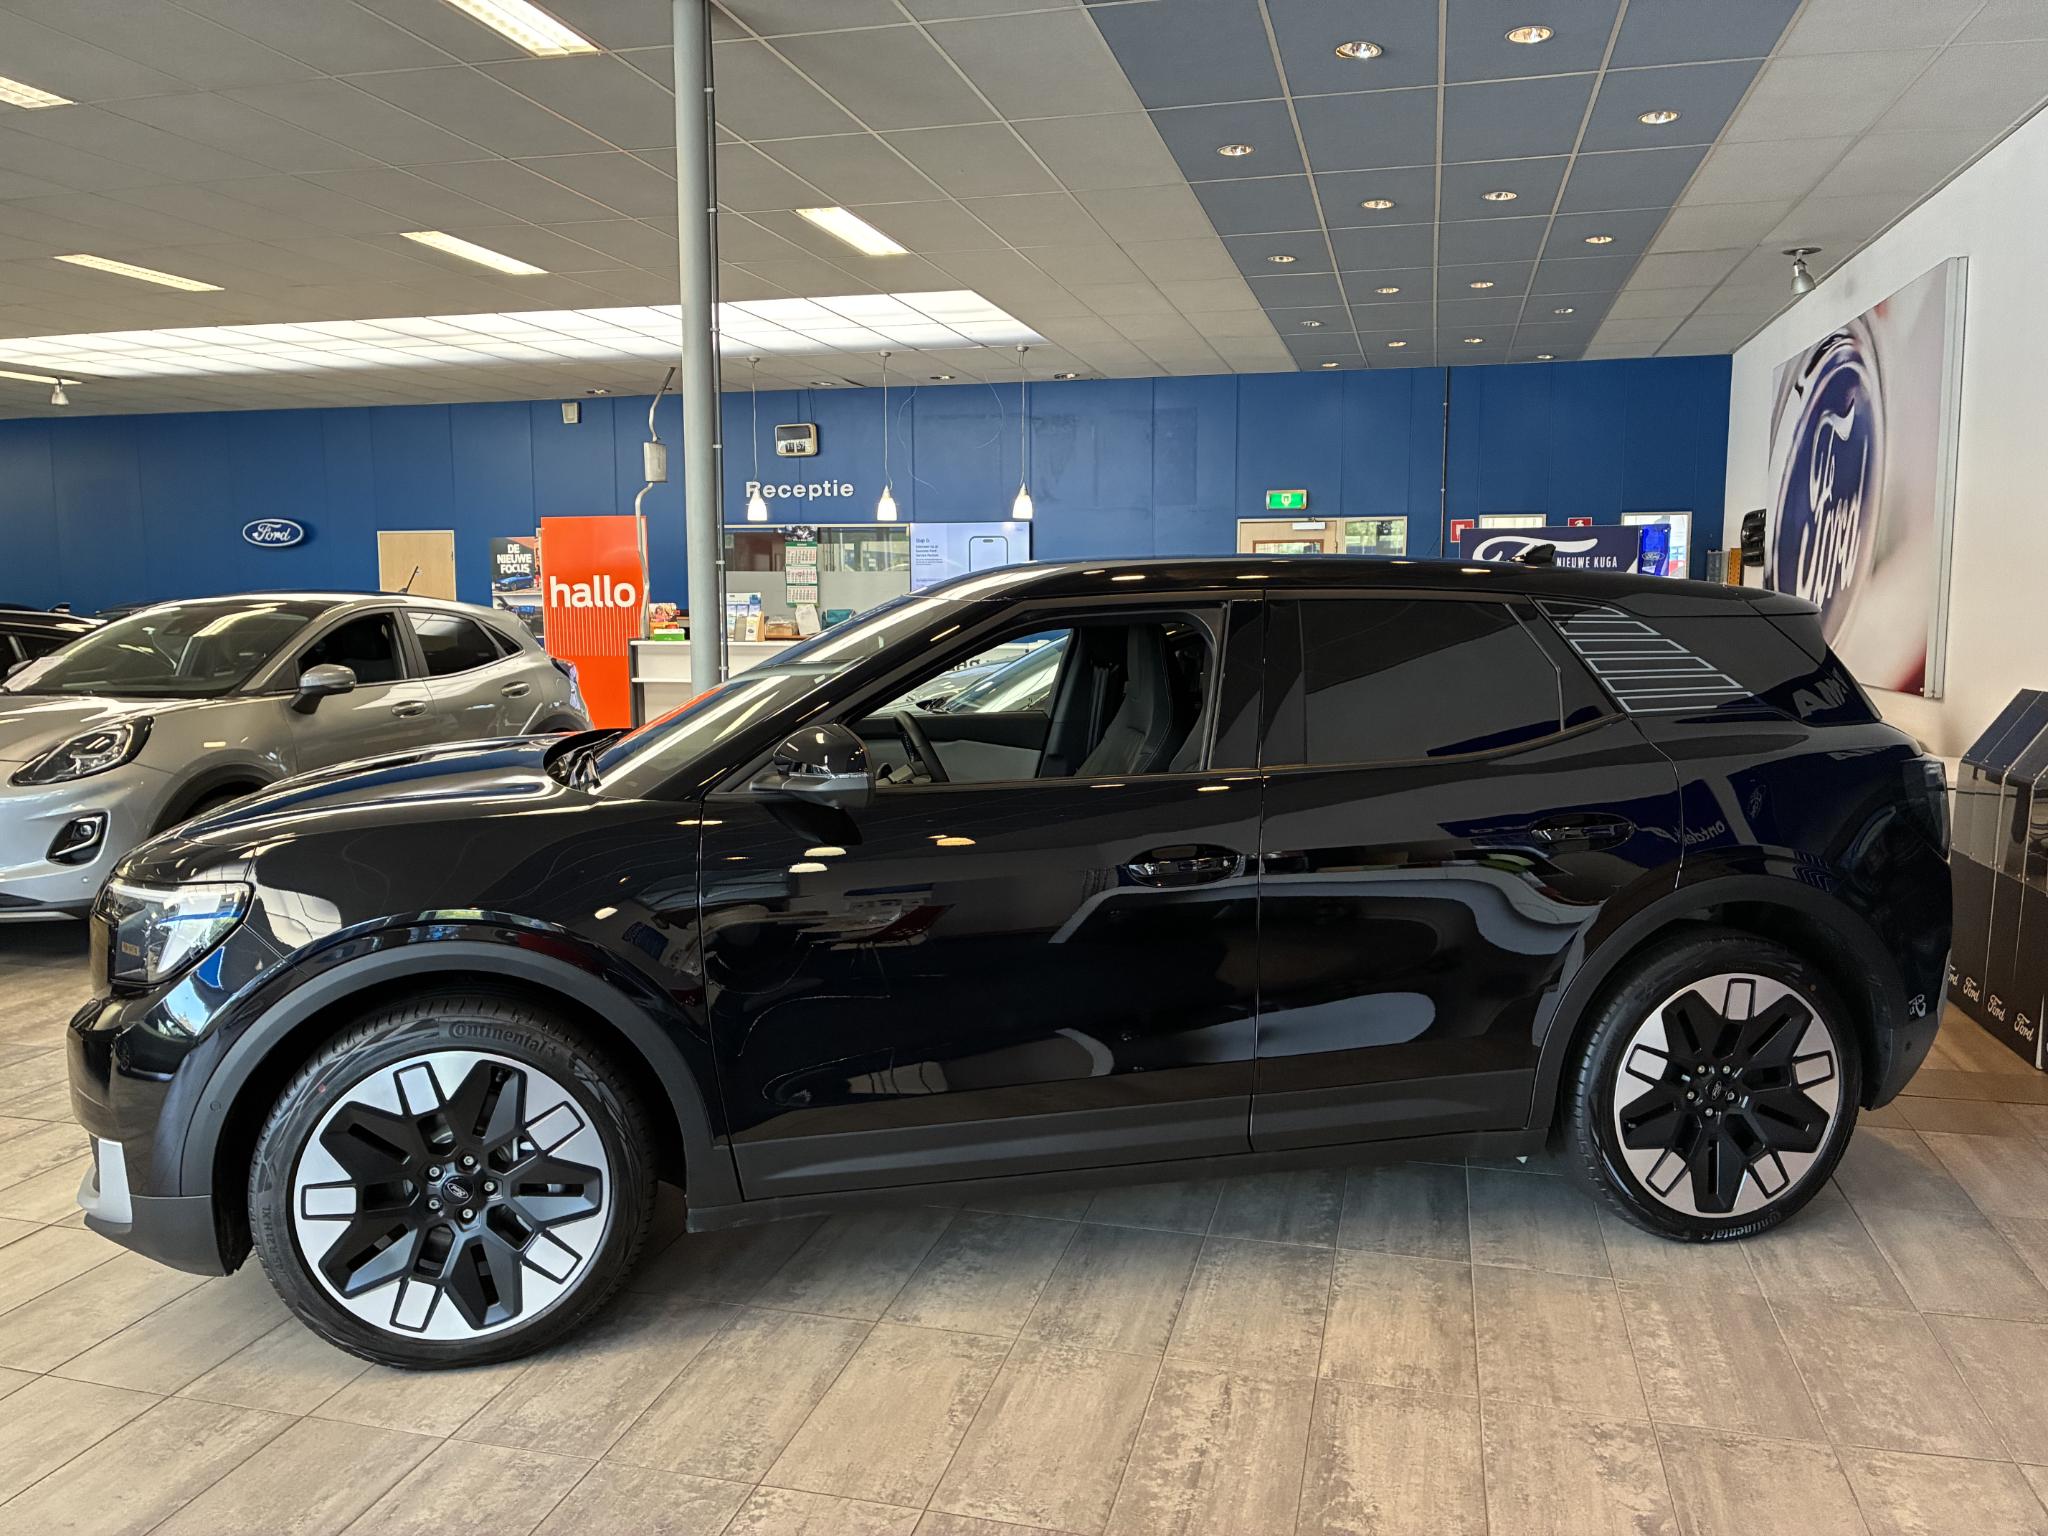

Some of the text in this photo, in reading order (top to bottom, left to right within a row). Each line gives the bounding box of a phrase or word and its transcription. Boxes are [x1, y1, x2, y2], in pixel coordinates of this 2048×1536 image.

[745, 480, 854, 501] Receptie
[1796, 406, 1868, 612] Ford
[496, 553, 533, 564] NIEUWE
[507, 543, 520, 554] DE
[1556, 556, 1618, 568] NIEUWE KUGA
[500, 564, 531, 574] FOCUS
[549, 574, 637, 608] hallo
[1962, 976, 1981, 1003] Ford
[1987, 994, 2007, 1022] Ford
[448, 1020, 547, 1053] Continental
[2013, 1012, 2036, 1042] Ford
